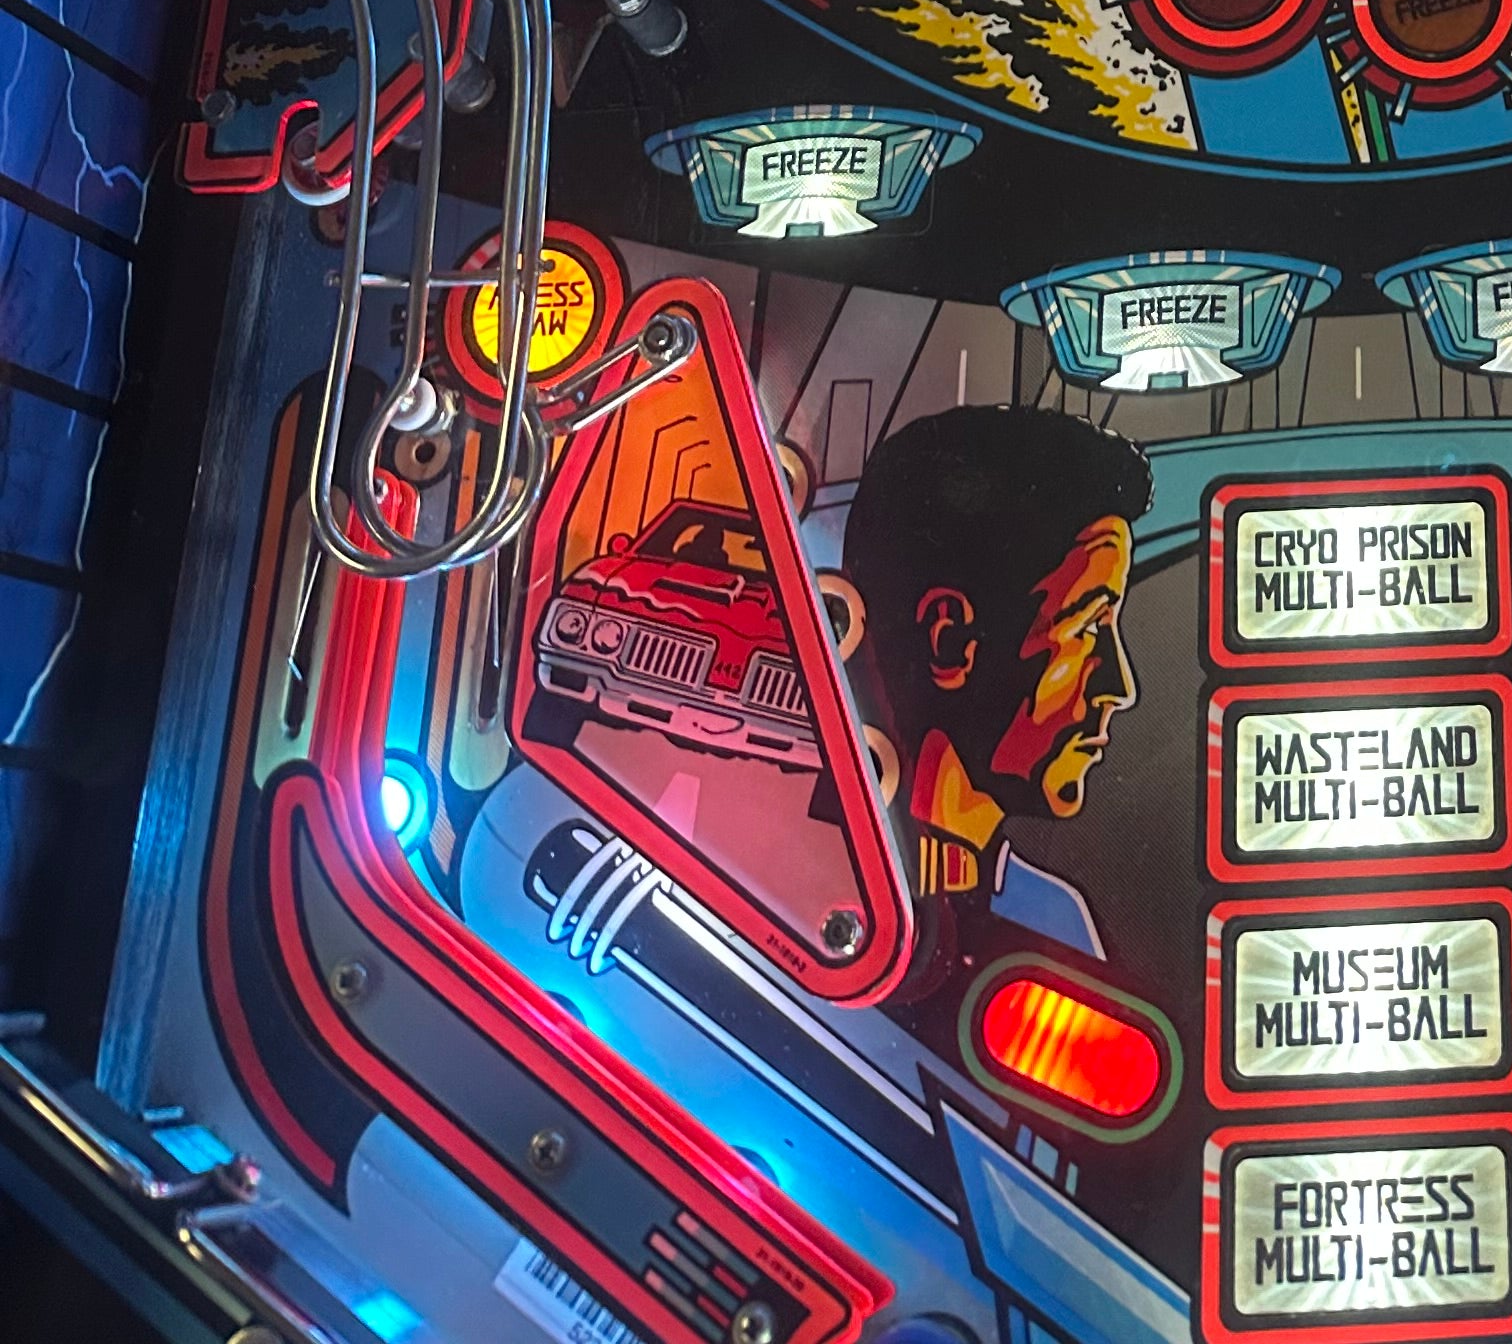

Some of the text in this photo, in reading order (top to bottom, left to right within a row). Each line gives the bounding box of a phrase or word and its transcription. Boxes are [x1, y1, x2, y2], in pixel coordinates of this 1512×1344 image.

[762, 147, 867, 180] FREEZE
[1120, 295, 1227, 328] FREEZE
[1254, 522, 1472, 567] CRYO PRISON
[1255, 564, 1473, 613] MULTI-BALL
[1254, 725, 1478, 776] WASTELAND
[1254, 772, 1480, 824] MULTI-BALL
[1292, 945, 1449, 996] MUSEUM
[1255, 993, 1488, 1048] MULTI-BALL
[1273, 1174, 1475, 1231] FORTRESS
[1254, 1226, 1496, 1286] MULTI-BALL
